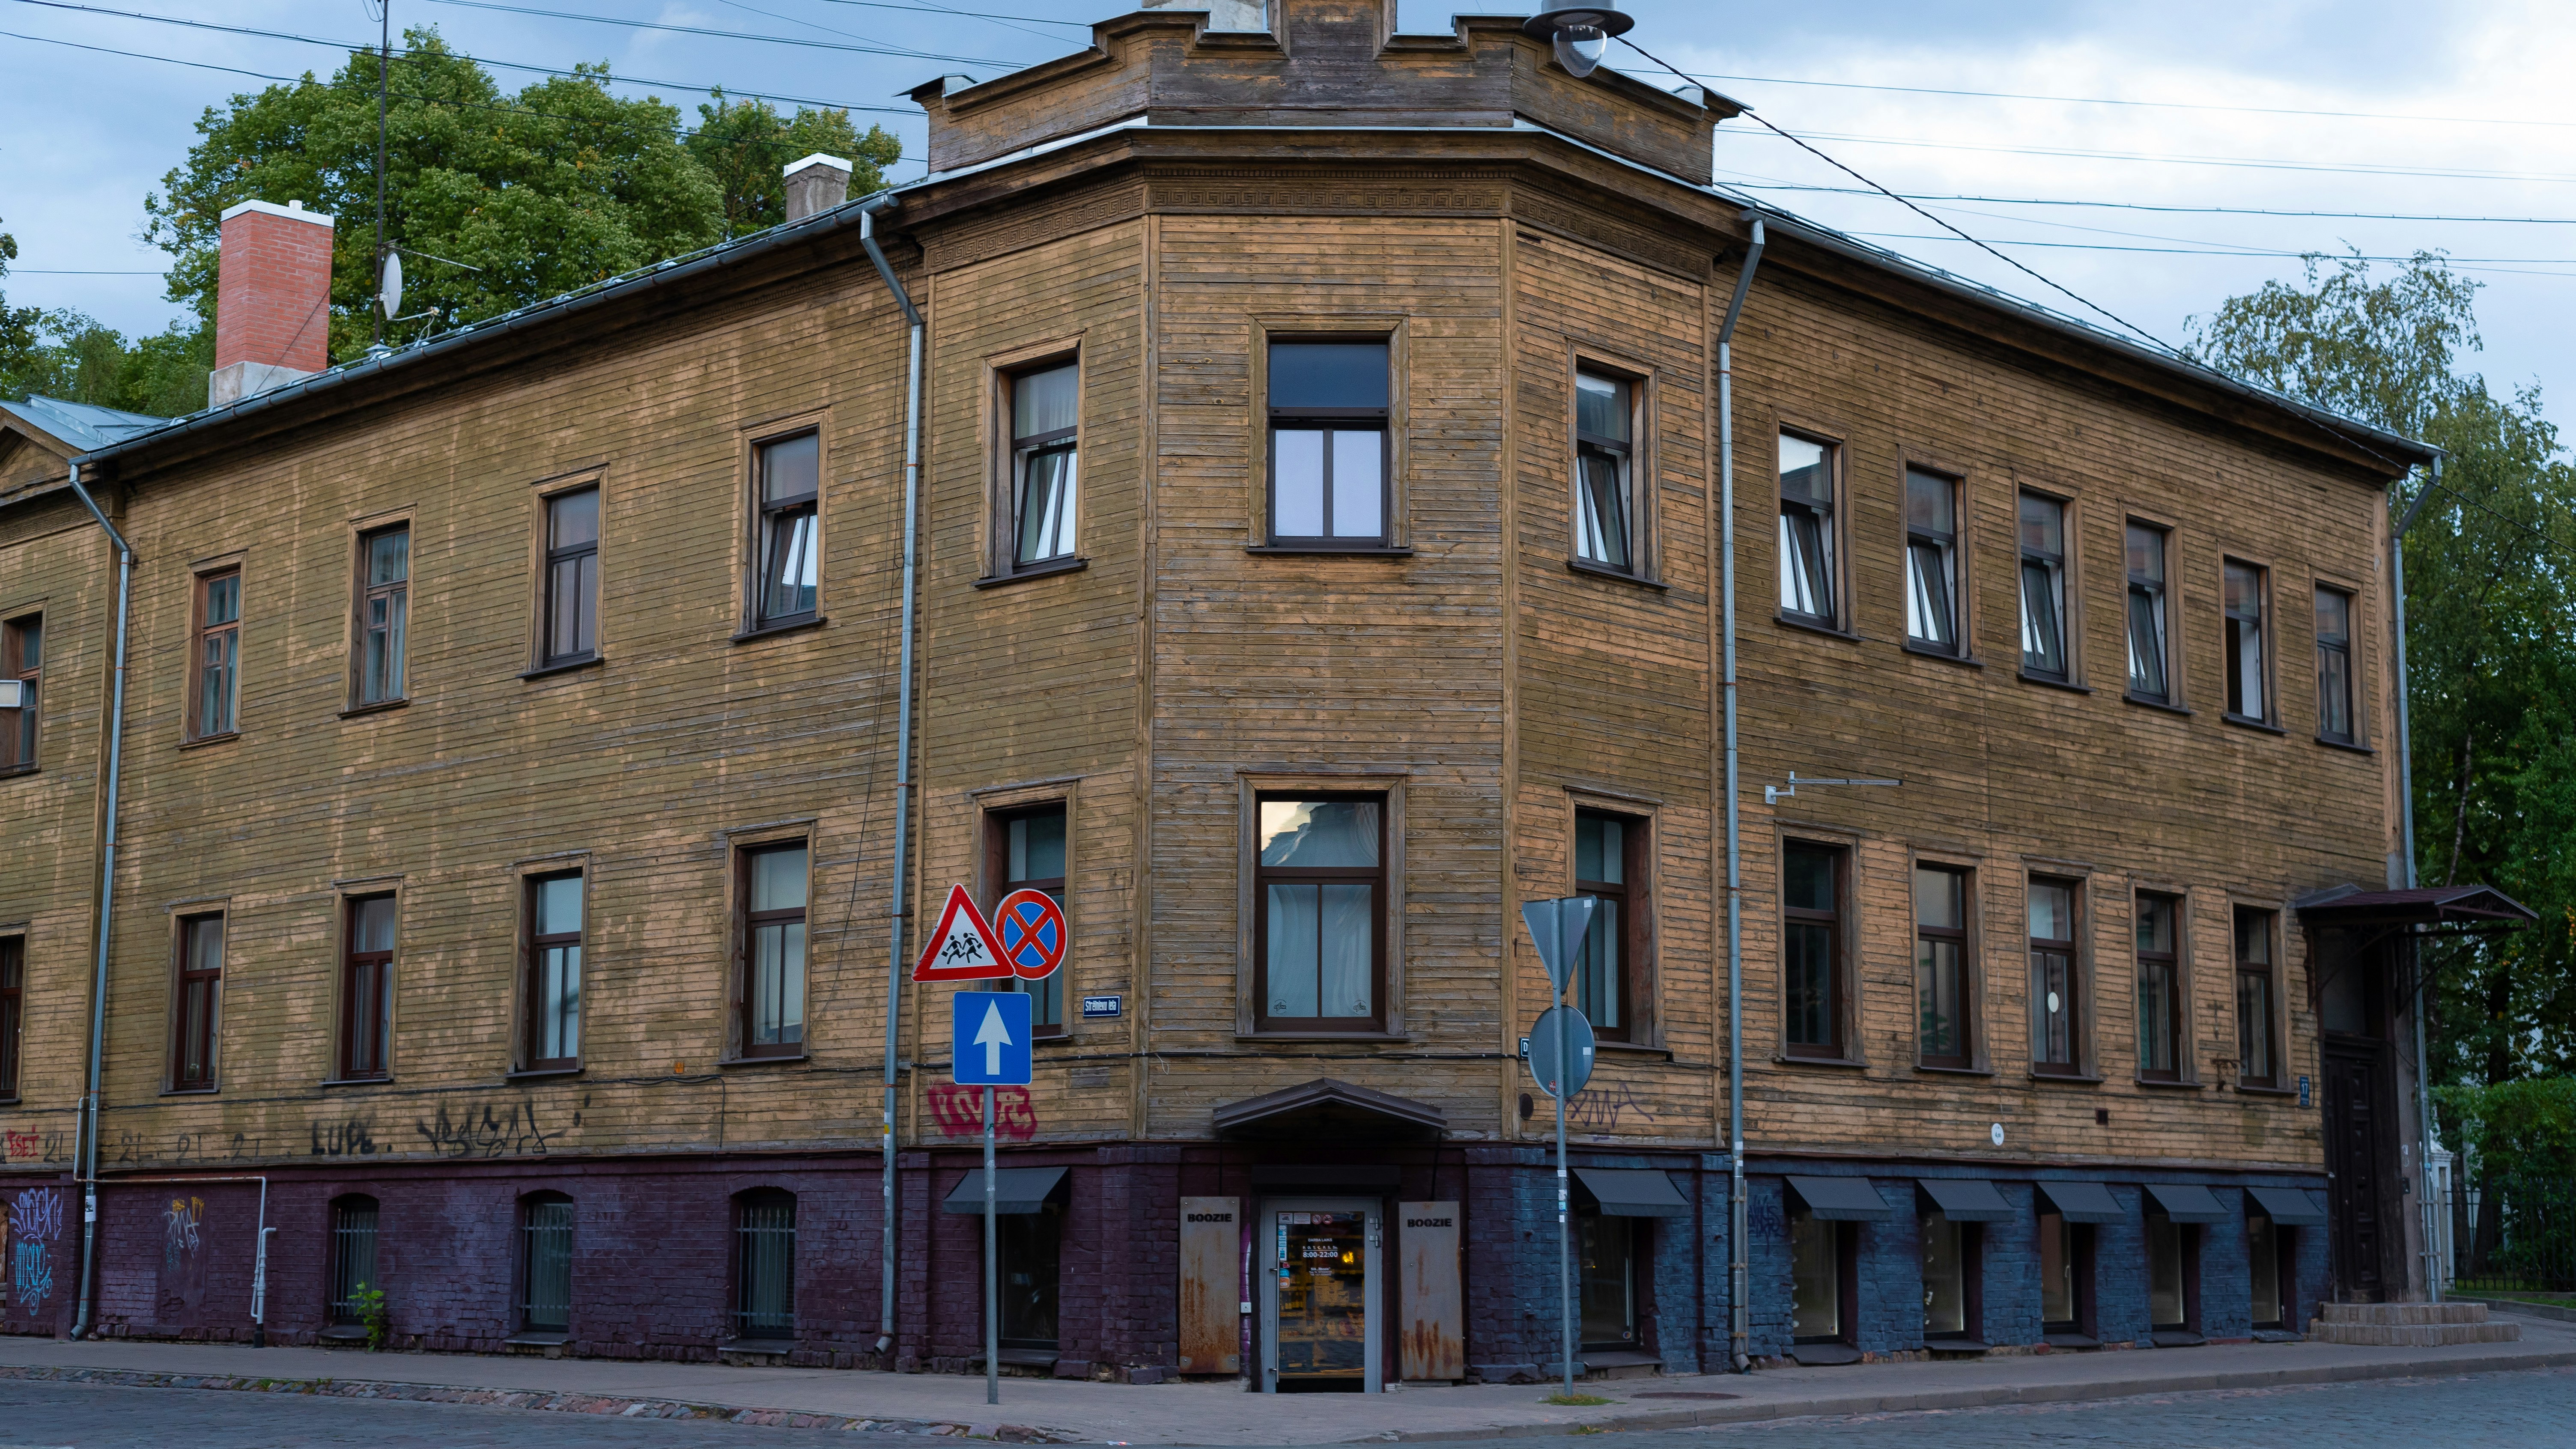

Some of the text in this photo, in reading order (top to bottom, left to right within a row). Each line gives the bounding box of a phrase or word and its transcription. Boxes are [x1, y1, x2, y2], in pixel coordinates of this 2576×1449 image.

[2301, 1083, 2308, 1094] 17
[1187, 1213, 1232, 1222] BOOZIE
[1407, 1218, 1452, 1228] BOOZIE
